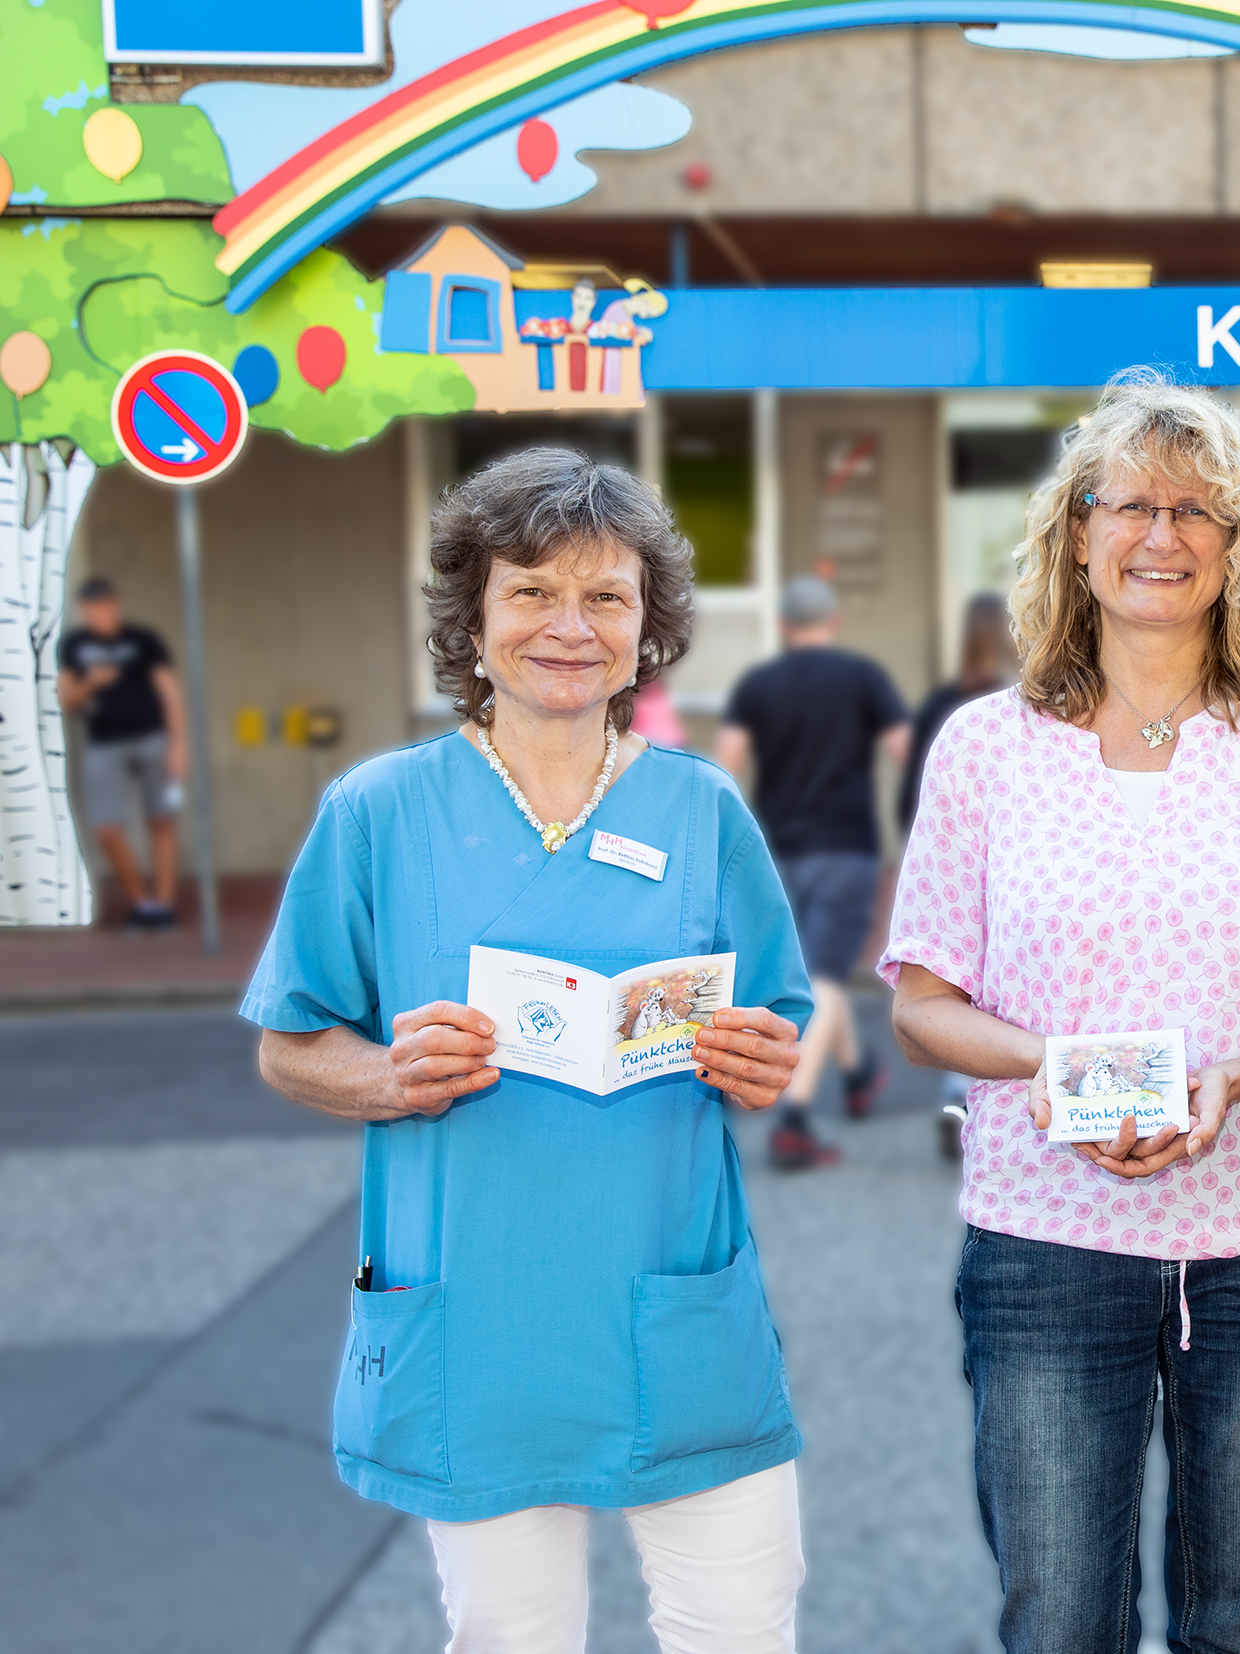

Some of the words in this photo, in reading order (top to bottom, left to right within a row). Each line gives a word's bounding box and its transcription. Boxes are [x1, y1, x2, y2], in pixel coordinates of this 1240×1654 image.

[620, 1039, 697, 1068] Pünktche
[622, 1069, 638, 1080] das
[640, 1062, 664, 1074] frühe
[668, 1056, 694, 1066] Mäusc
[1068, 1105, 1166, 1122] Pünktchen
[1072, 1124, 1090, 1133] das
